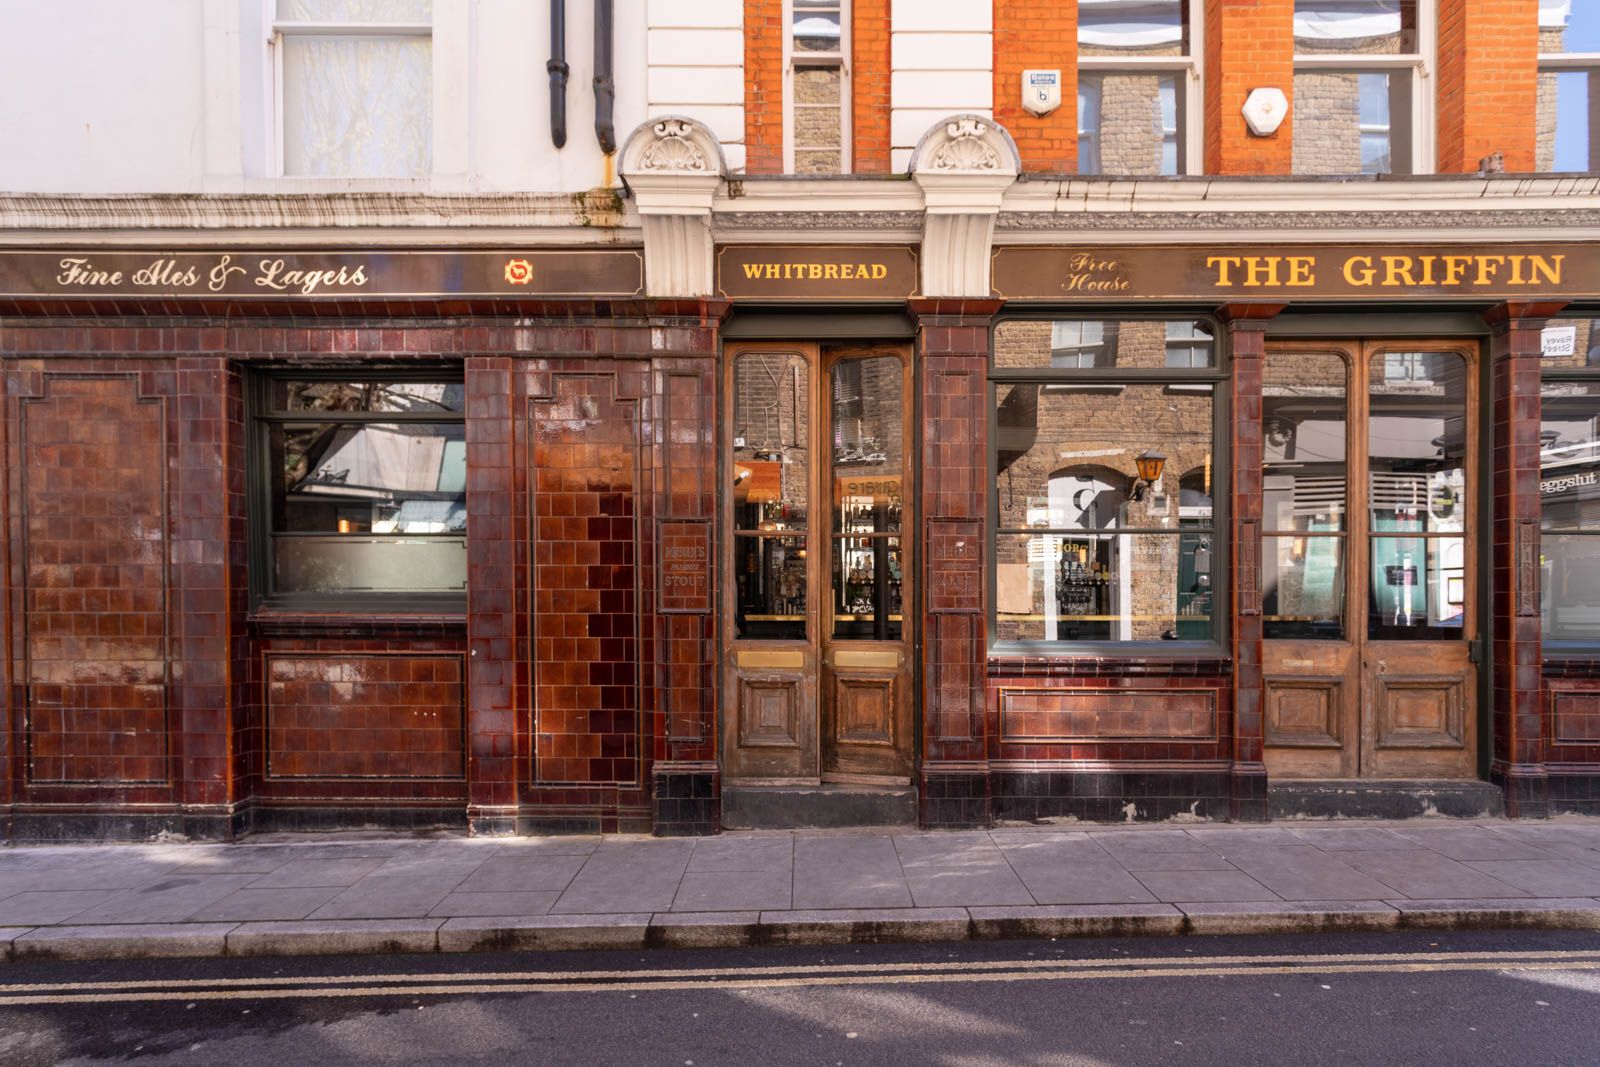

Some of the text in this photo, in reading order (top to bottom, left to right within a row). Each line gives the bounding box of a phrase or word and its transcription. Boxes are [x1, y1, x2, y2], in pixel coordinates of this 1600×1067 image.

[743, 263, 888, 280] WHITBREAD
[1069, 252, 1119, 273] Free
[1206, 254, 1566, 287] THE GRIFFIN
[56, 254, 369, 293] Fine Ales & Lagers
[1061, 271, 1131, 292] House
[1539, 472, 1597, 493] eggslut
[664, 576, 705, 587] STOUT
